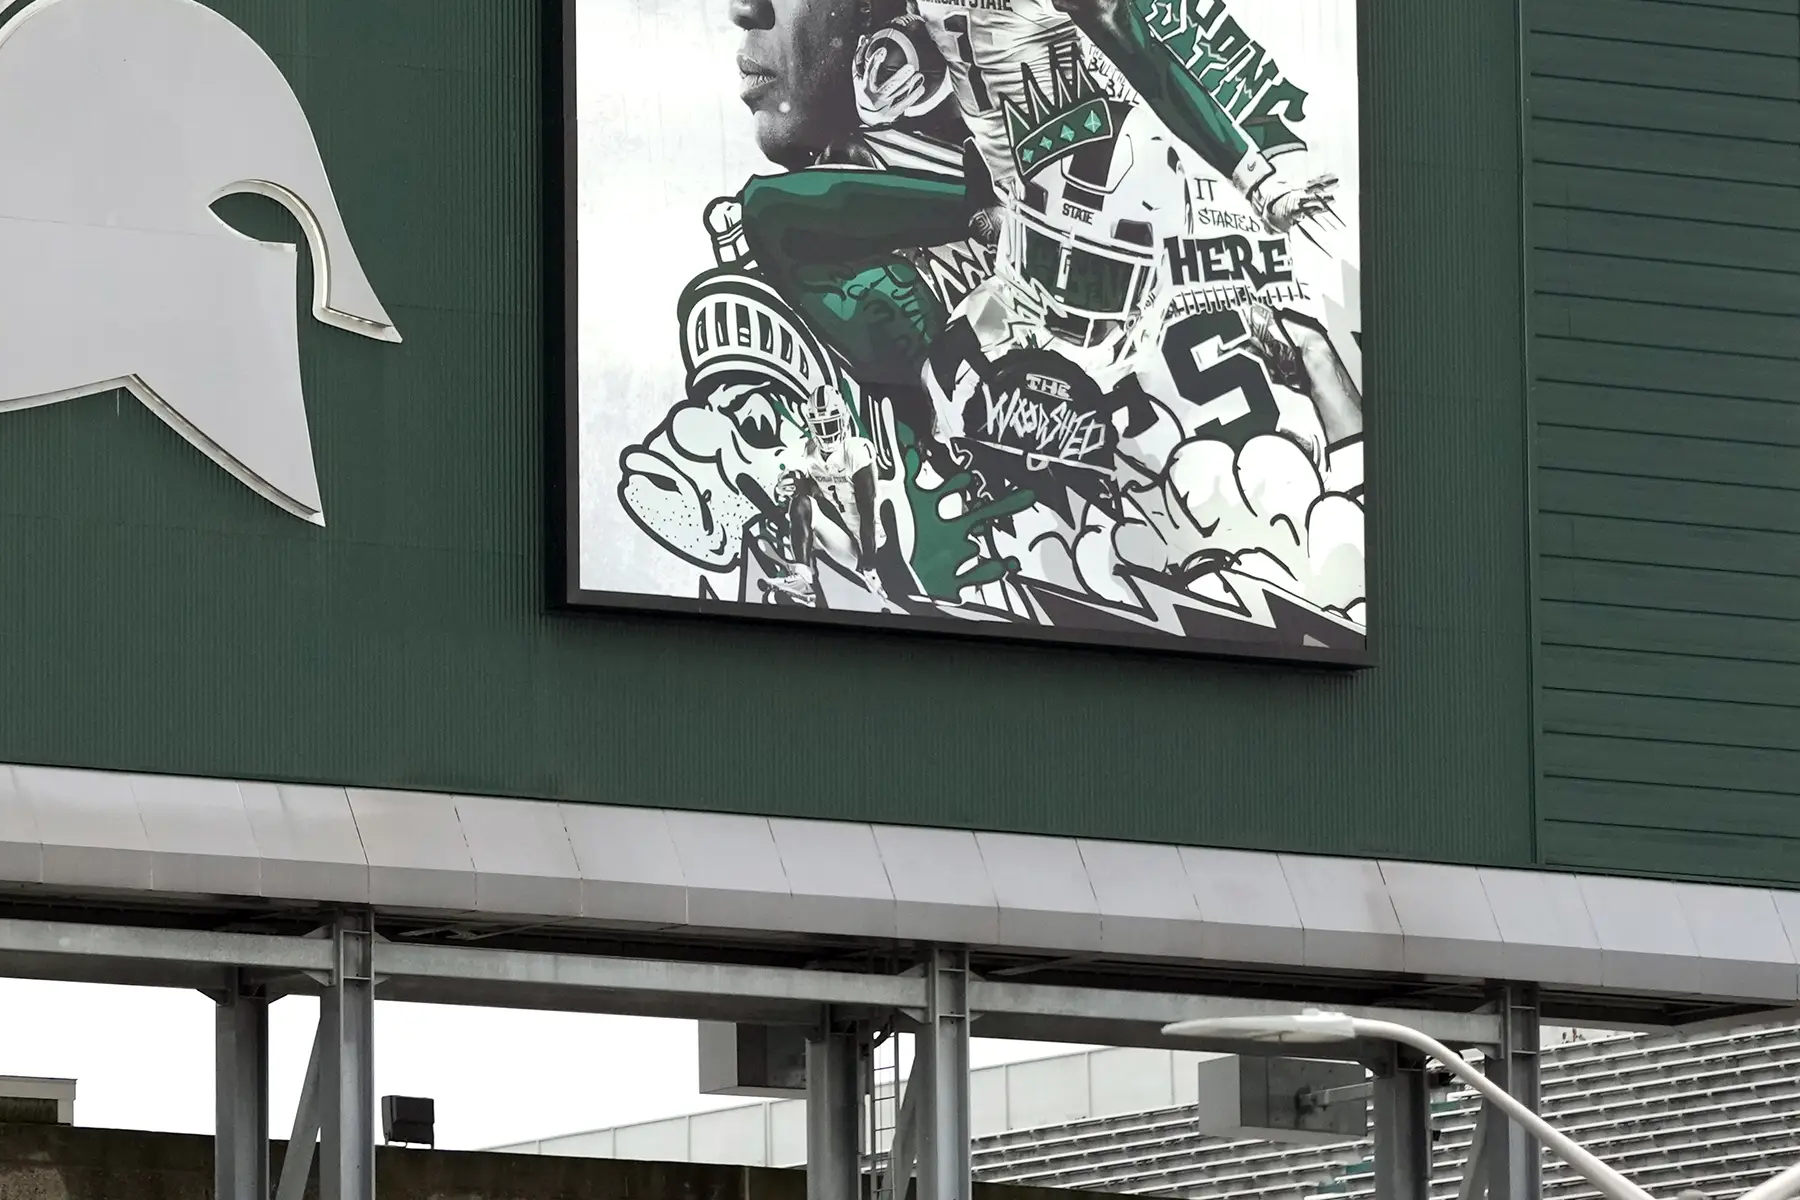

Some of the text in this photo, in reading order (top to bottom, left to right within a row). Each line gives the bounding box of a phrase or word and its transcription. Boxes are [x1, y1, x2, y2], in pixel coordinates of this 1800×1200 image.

[1193, 177, 1218, 202] IT
[1062, 202, 1094, 226] STATE
[1197, 206, 1261, 233] STARTED
[1162, 233, 1294, 292] HERE
[1026, 373, 1073, 401] THE
